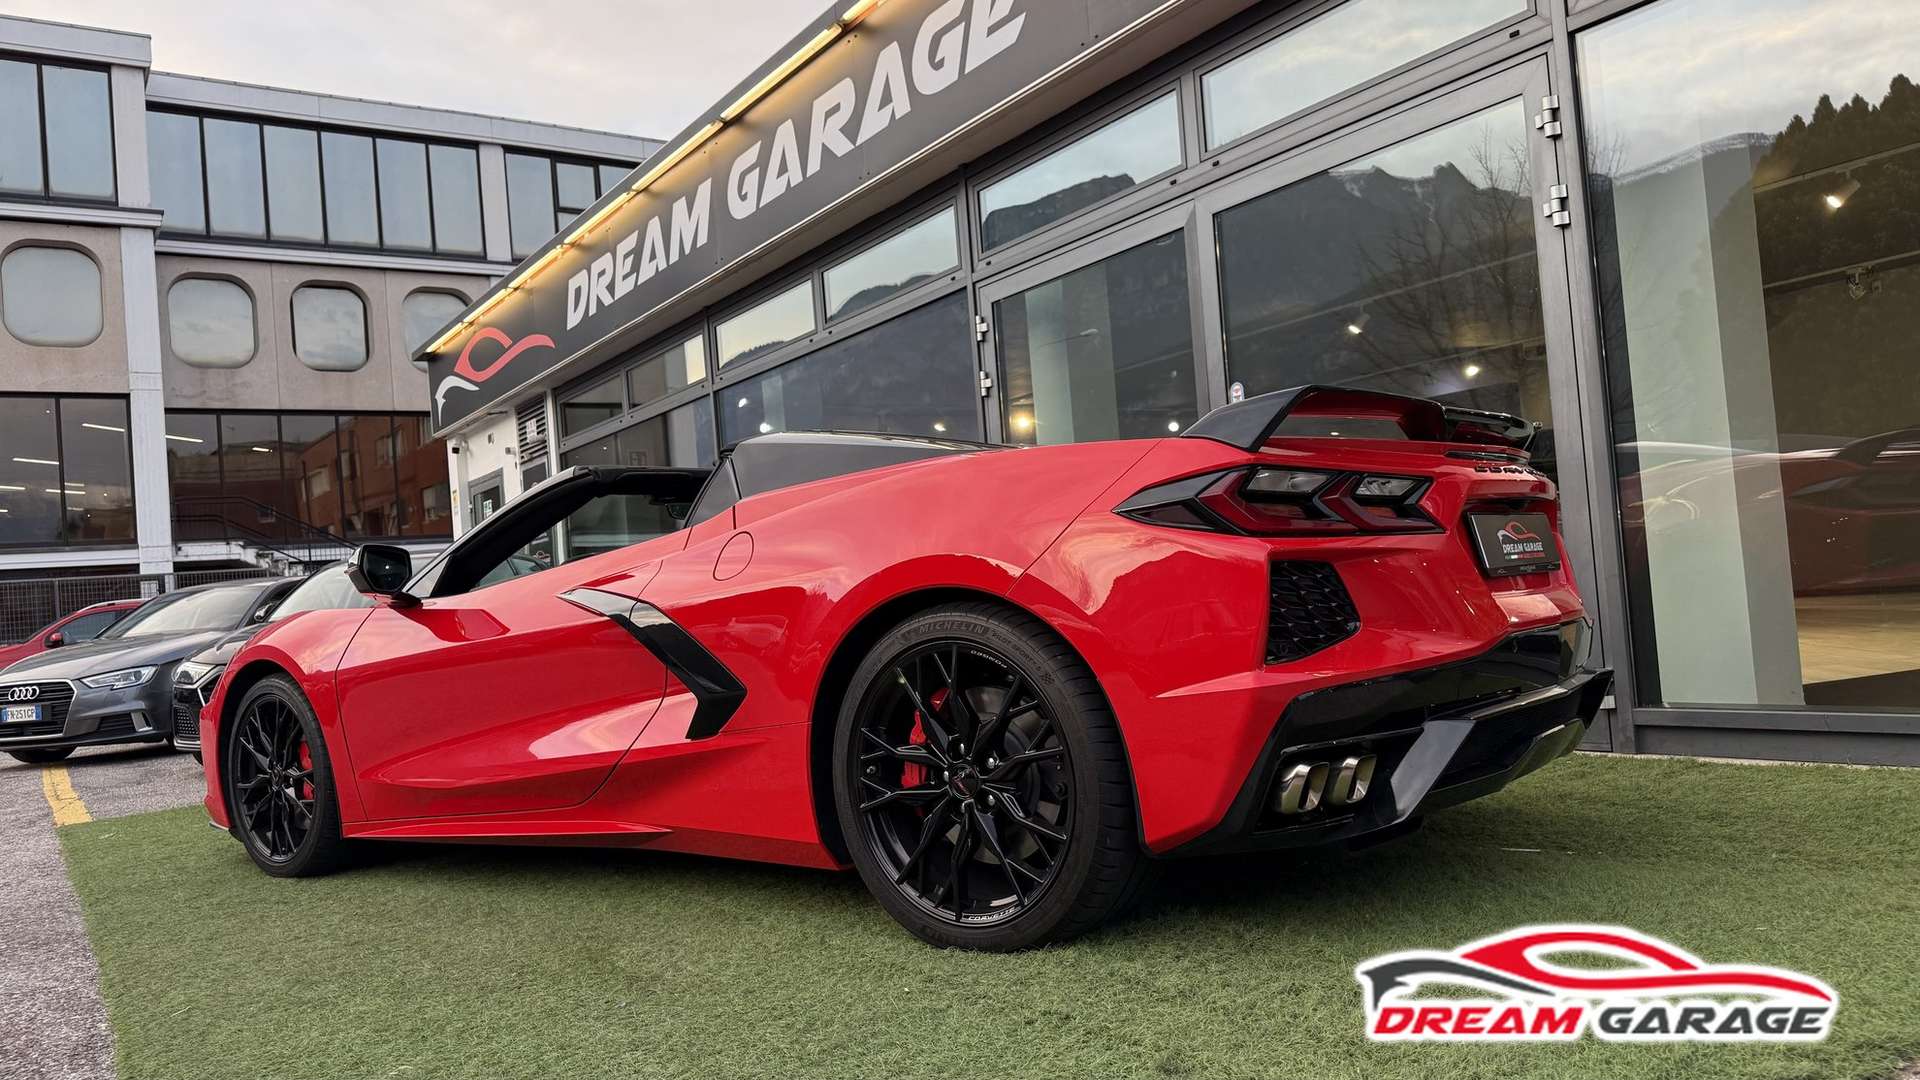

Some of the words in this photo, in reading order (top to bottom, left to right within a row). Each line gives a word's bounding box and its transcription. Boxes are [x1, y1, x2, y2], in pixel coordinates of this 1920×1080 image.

[566, 177, 712, 330] DREAM
[727, 0, 1027, 220] GARAGE
[1502, 543, 1523, 553] DREAM
[1523, 541, 1544, 551] GARAGE
[919, 620, 985, 634] MICHELIN
